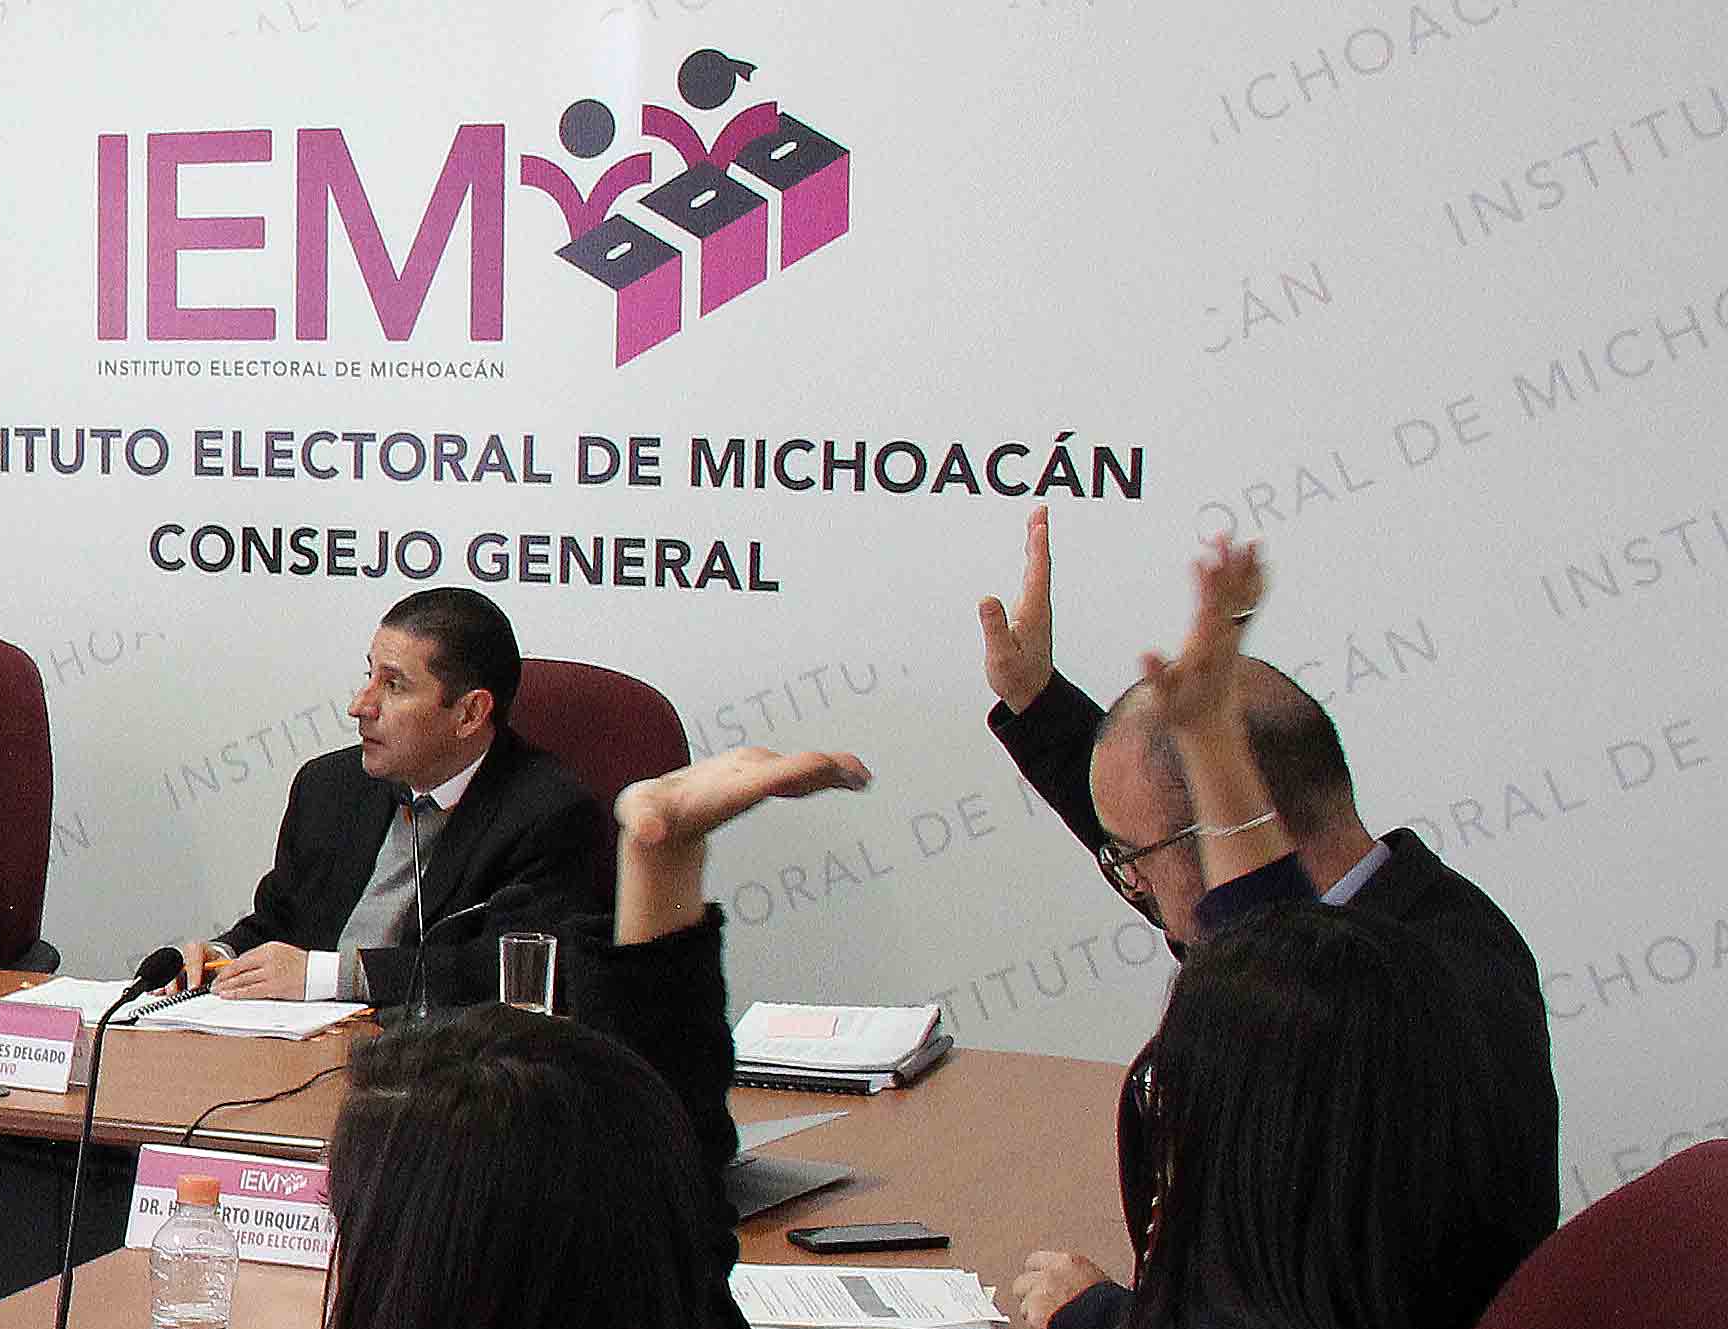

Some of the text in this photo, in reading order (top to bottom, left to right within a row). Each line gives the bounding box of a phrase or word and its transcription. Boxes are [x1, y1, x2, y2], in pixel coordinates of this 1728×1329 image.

[98, 123, 504, 341] IEM
[98, 358, 505, 379] INSTITUTO ELECTORAL DE MICHOACÁN
[194, 430, 552, 485] ELECTORAL
[592, 435, 662, 487] DE
[690, 432, 1145, 499] MICHOACÁN
[1393, 395, 1492, 468] DE
[148, 525, 780, 593] CONSEJO GENERAL
[1604, 718, 1711, 791] DE
[13, 1045, 66, 1064] DELGADO
[240, 1168, 279, 1193] IEM
[139, 1197, 163, 1216] DR.
[254, 1211, 320, 1233] URQUIZA
